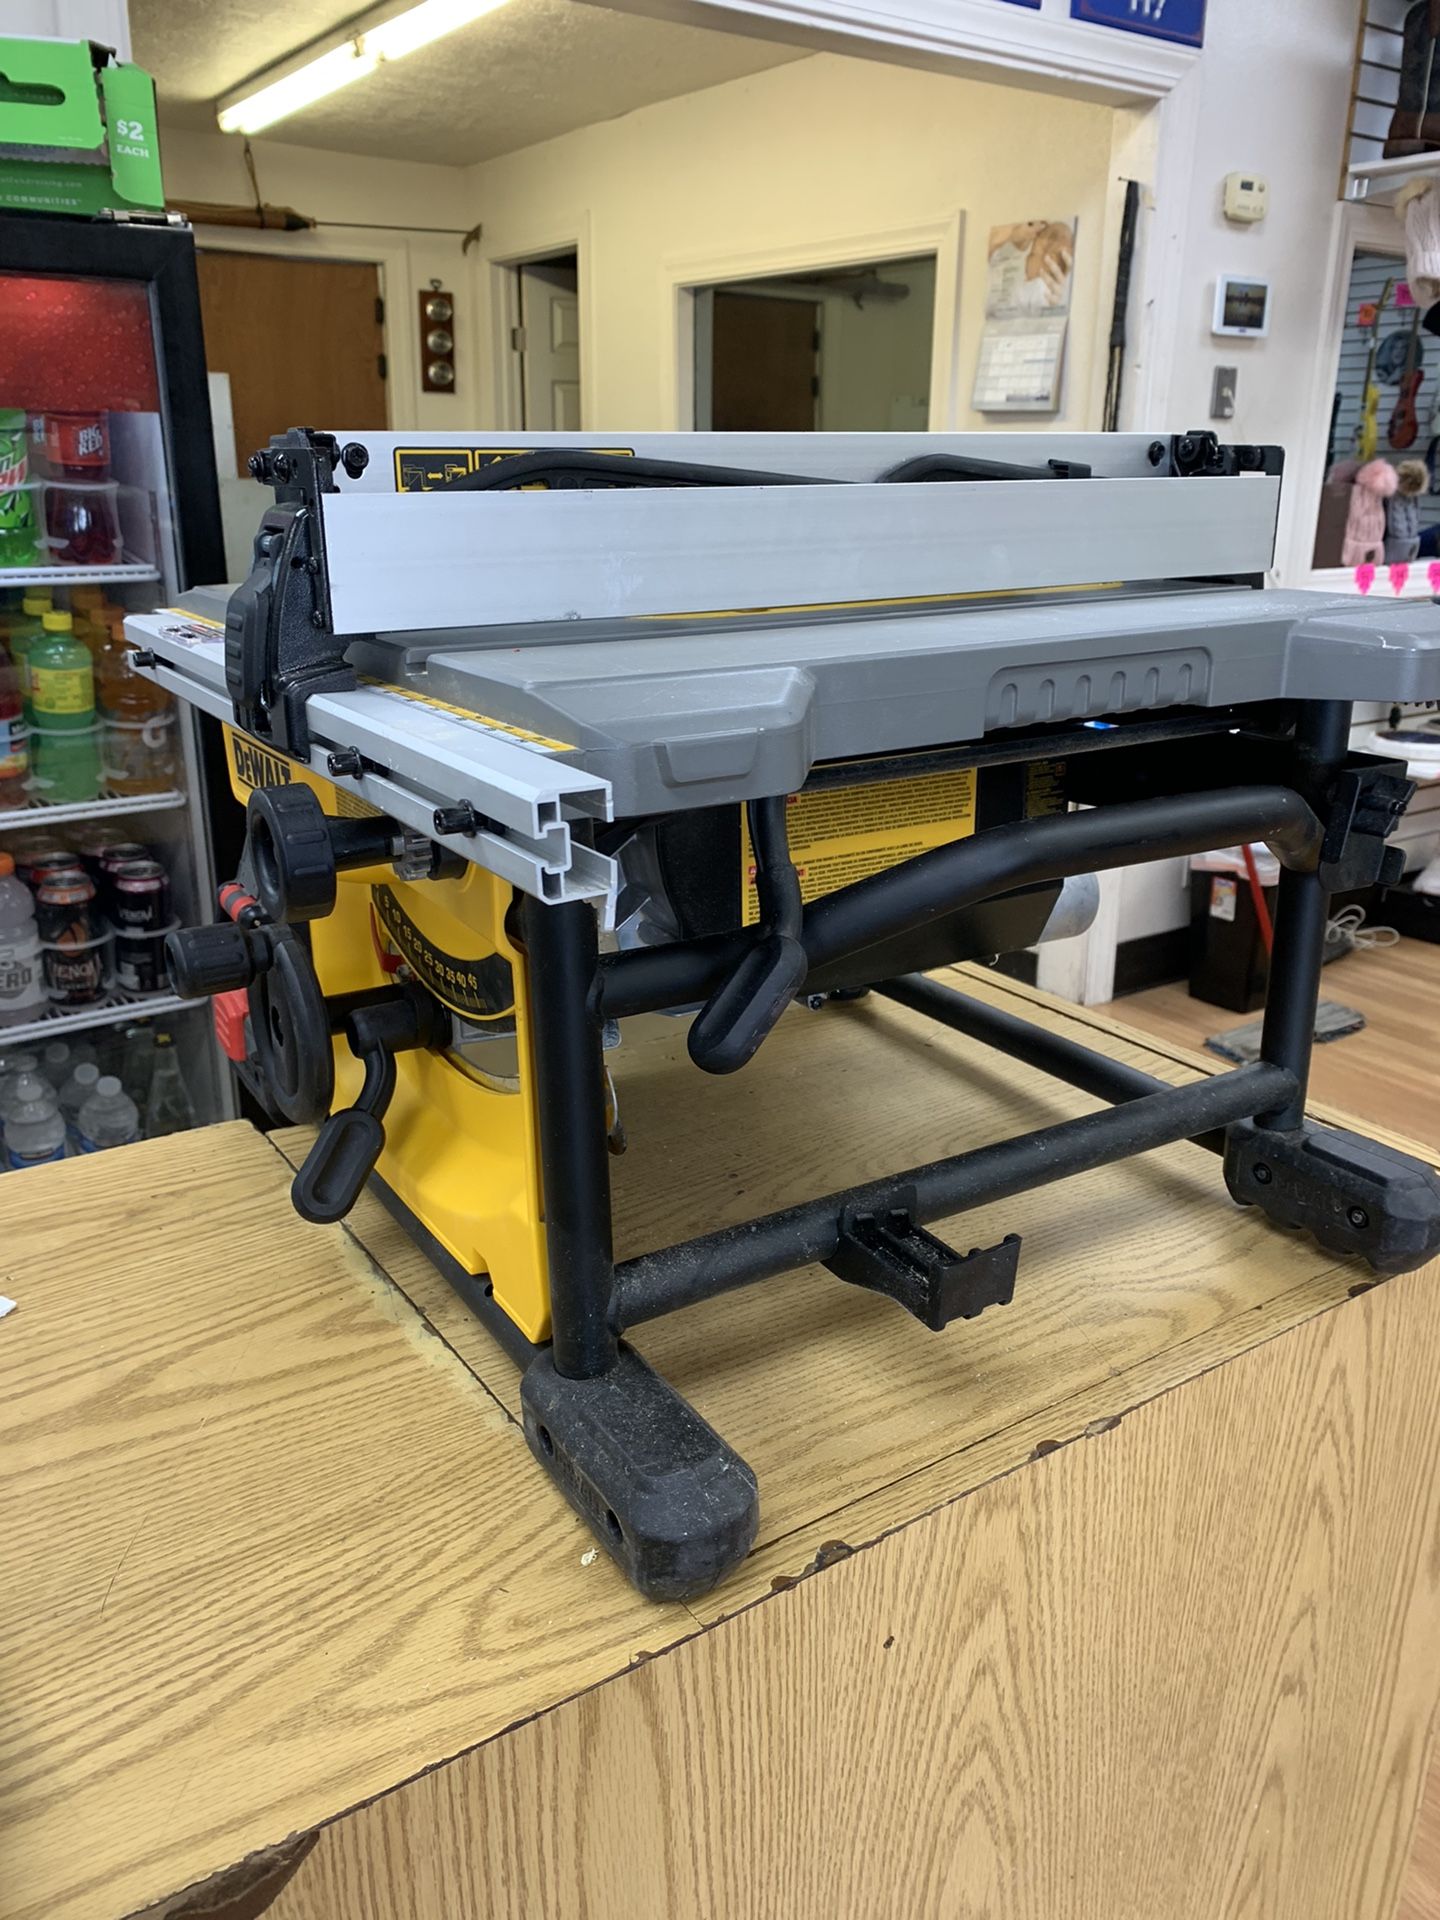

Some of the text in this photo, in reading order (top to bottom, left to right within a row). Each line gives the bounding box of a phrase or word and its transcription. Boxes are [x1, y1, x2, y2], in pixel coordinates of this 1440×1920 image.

[116, 119, 144, 141] $2
[116, 144, 150, 158] EACH
[79, 424, 100, 442] BIG
[79, 435, 103, 455] RED
[403, 925, 412, 940] 15
[456, 972, 467, 988] 40
[467, 973, 478, 990] 45
